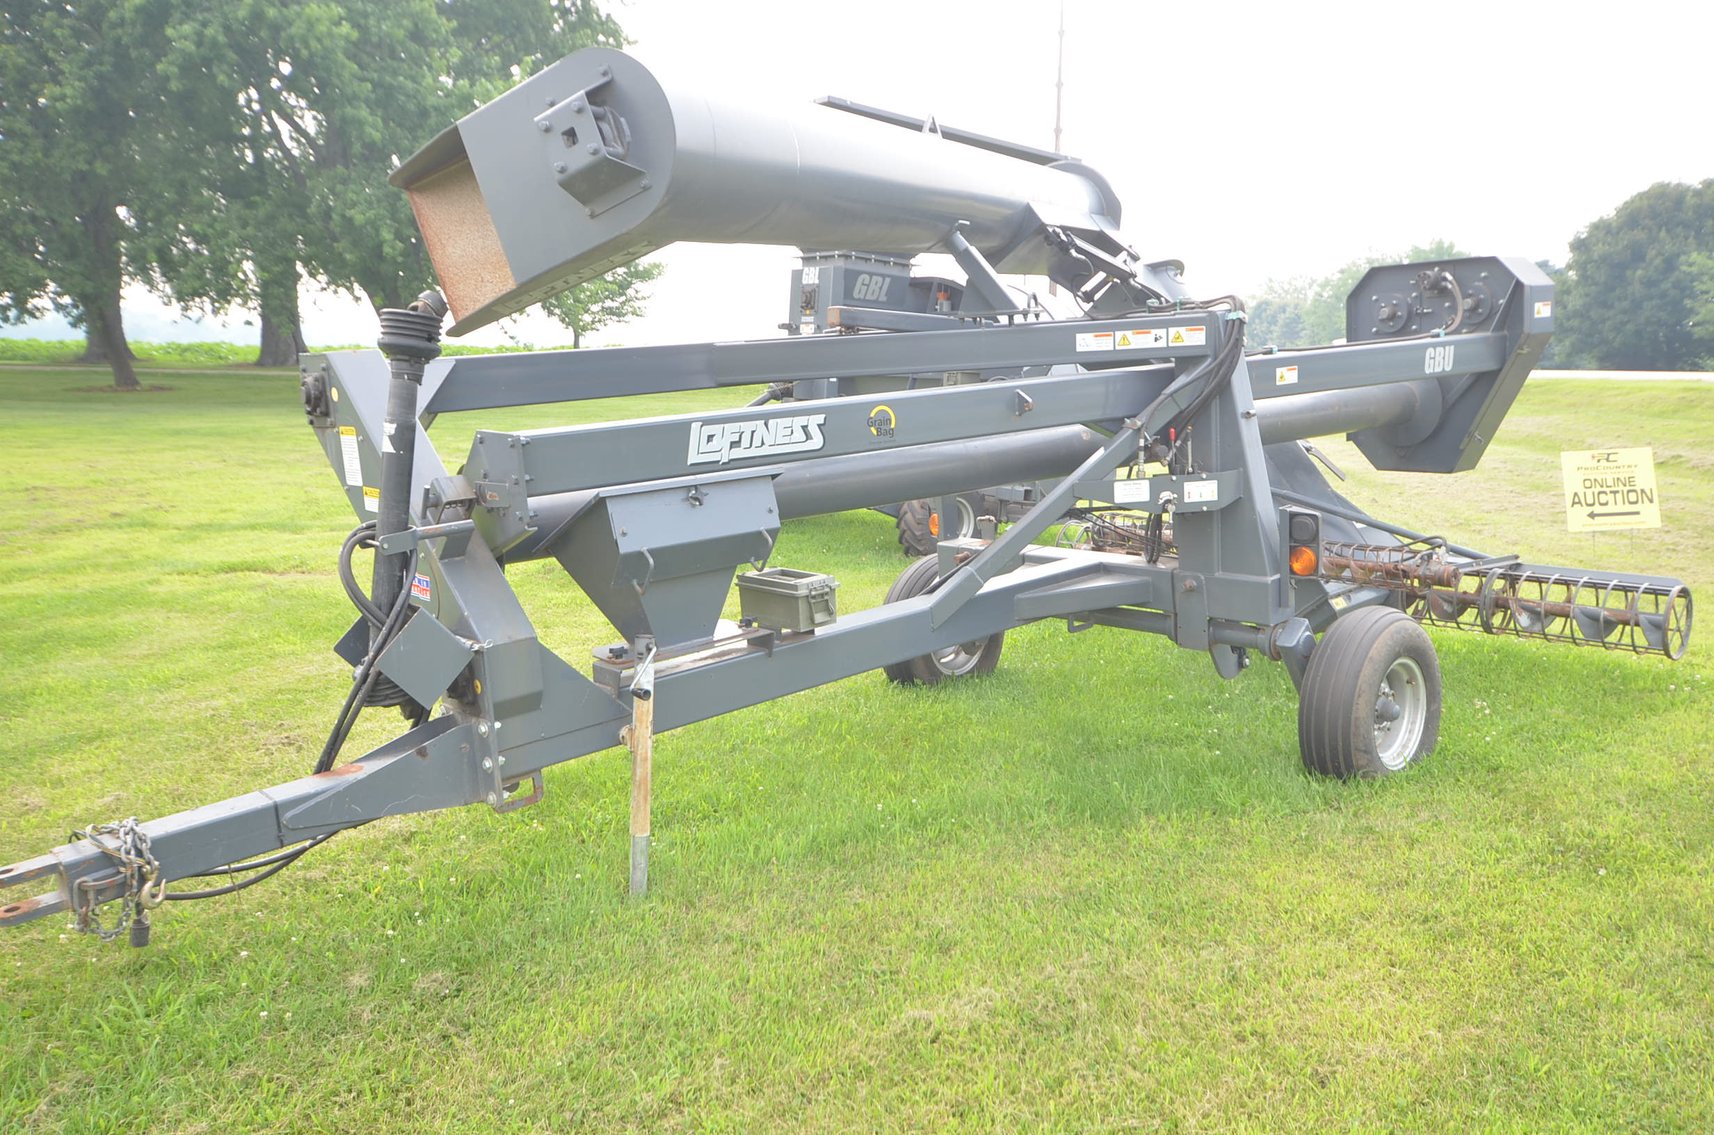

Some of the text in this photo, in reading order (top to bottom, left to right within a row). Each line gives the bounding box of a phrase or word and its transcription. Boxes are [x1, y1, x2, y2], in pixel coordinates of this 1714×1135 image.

[802, 267, 819, 284] GBL
[853, 273, 892, 302] GBL
[1425, 345, 1455, 374] GBU
[866, 416, 892, 429] Grain
[687, 414, 826, 465] LOFTNESS
[876, 427, 895, 439] Bag
[1583, 476, 1636, 489] ONLINE
[1571, 488, 1654, 507] AUCTION
